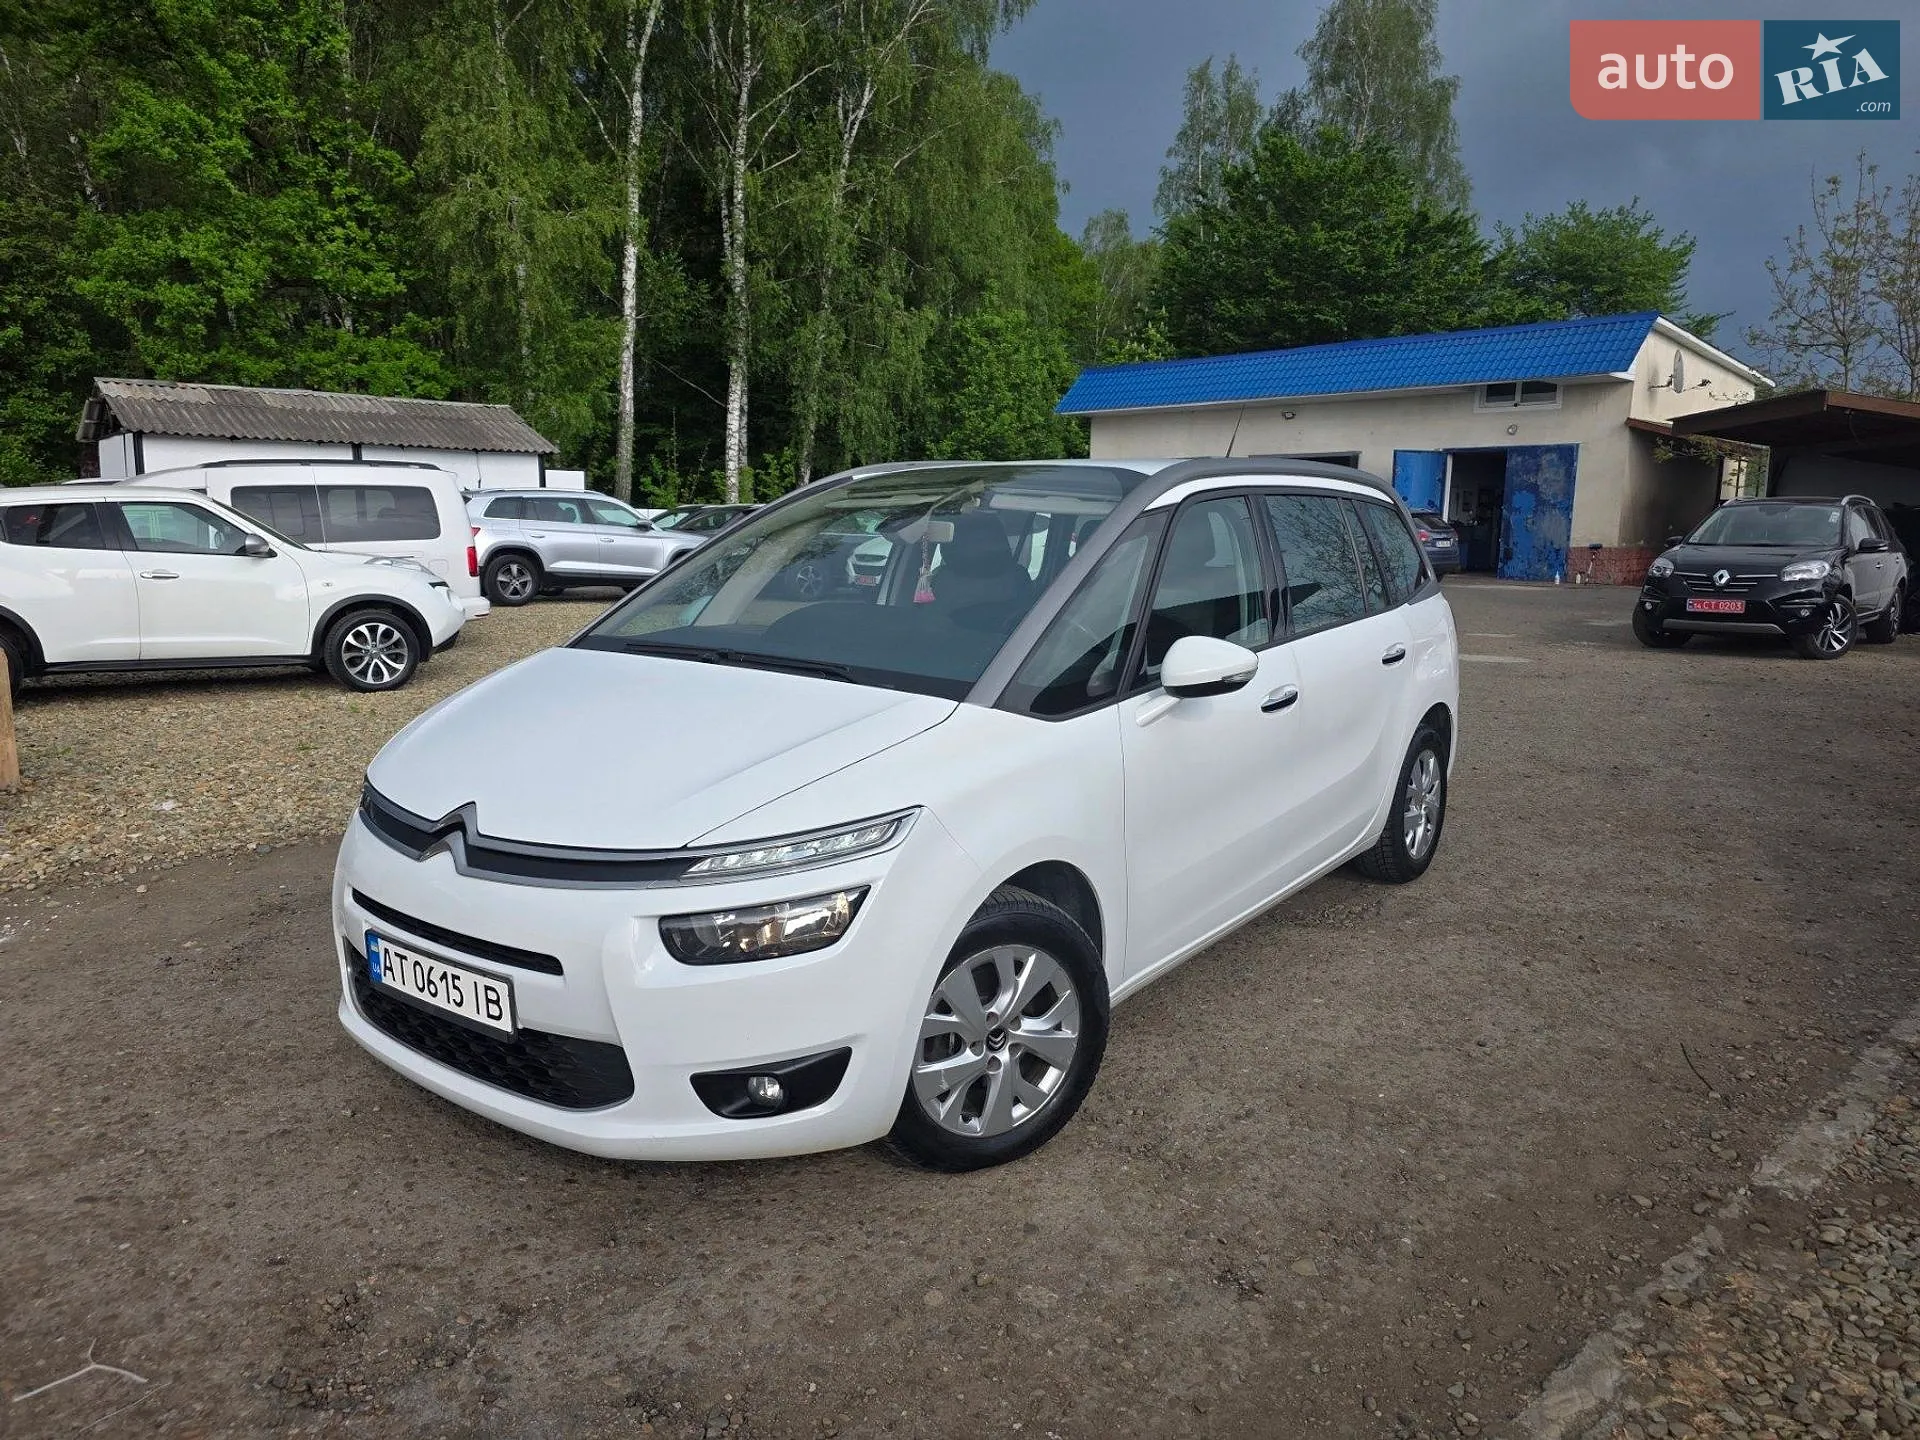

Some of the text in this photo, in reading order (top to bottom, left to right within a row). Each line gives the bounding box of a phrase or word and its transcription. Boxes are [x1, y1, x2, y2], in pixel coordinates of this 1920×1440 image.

[383, 947, 503, 1021] AT 0615 IB
